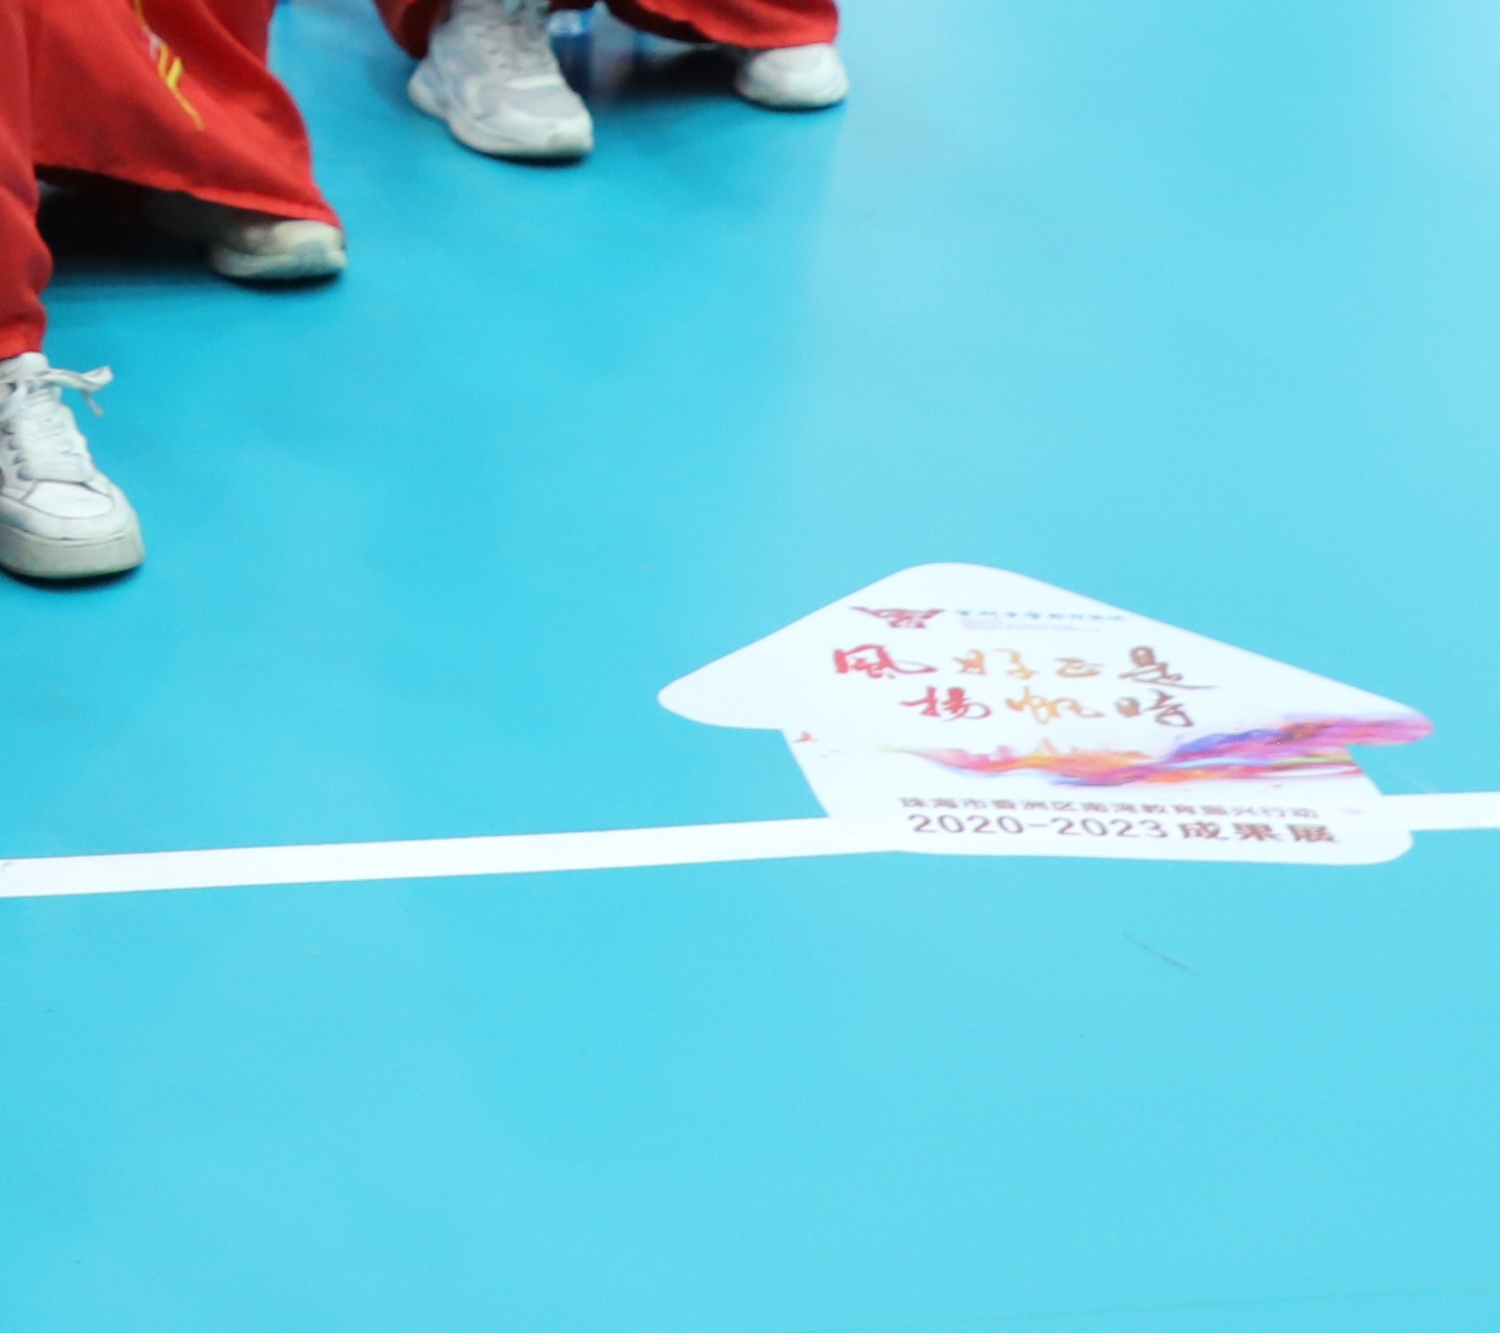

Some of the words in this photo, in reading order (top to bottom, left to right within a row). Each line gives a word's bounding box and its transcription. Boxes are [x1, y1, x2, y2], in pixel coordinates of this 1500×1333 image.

[899, 796, 1320, 820] 珠海市香洲区南湾教育振兴行动
